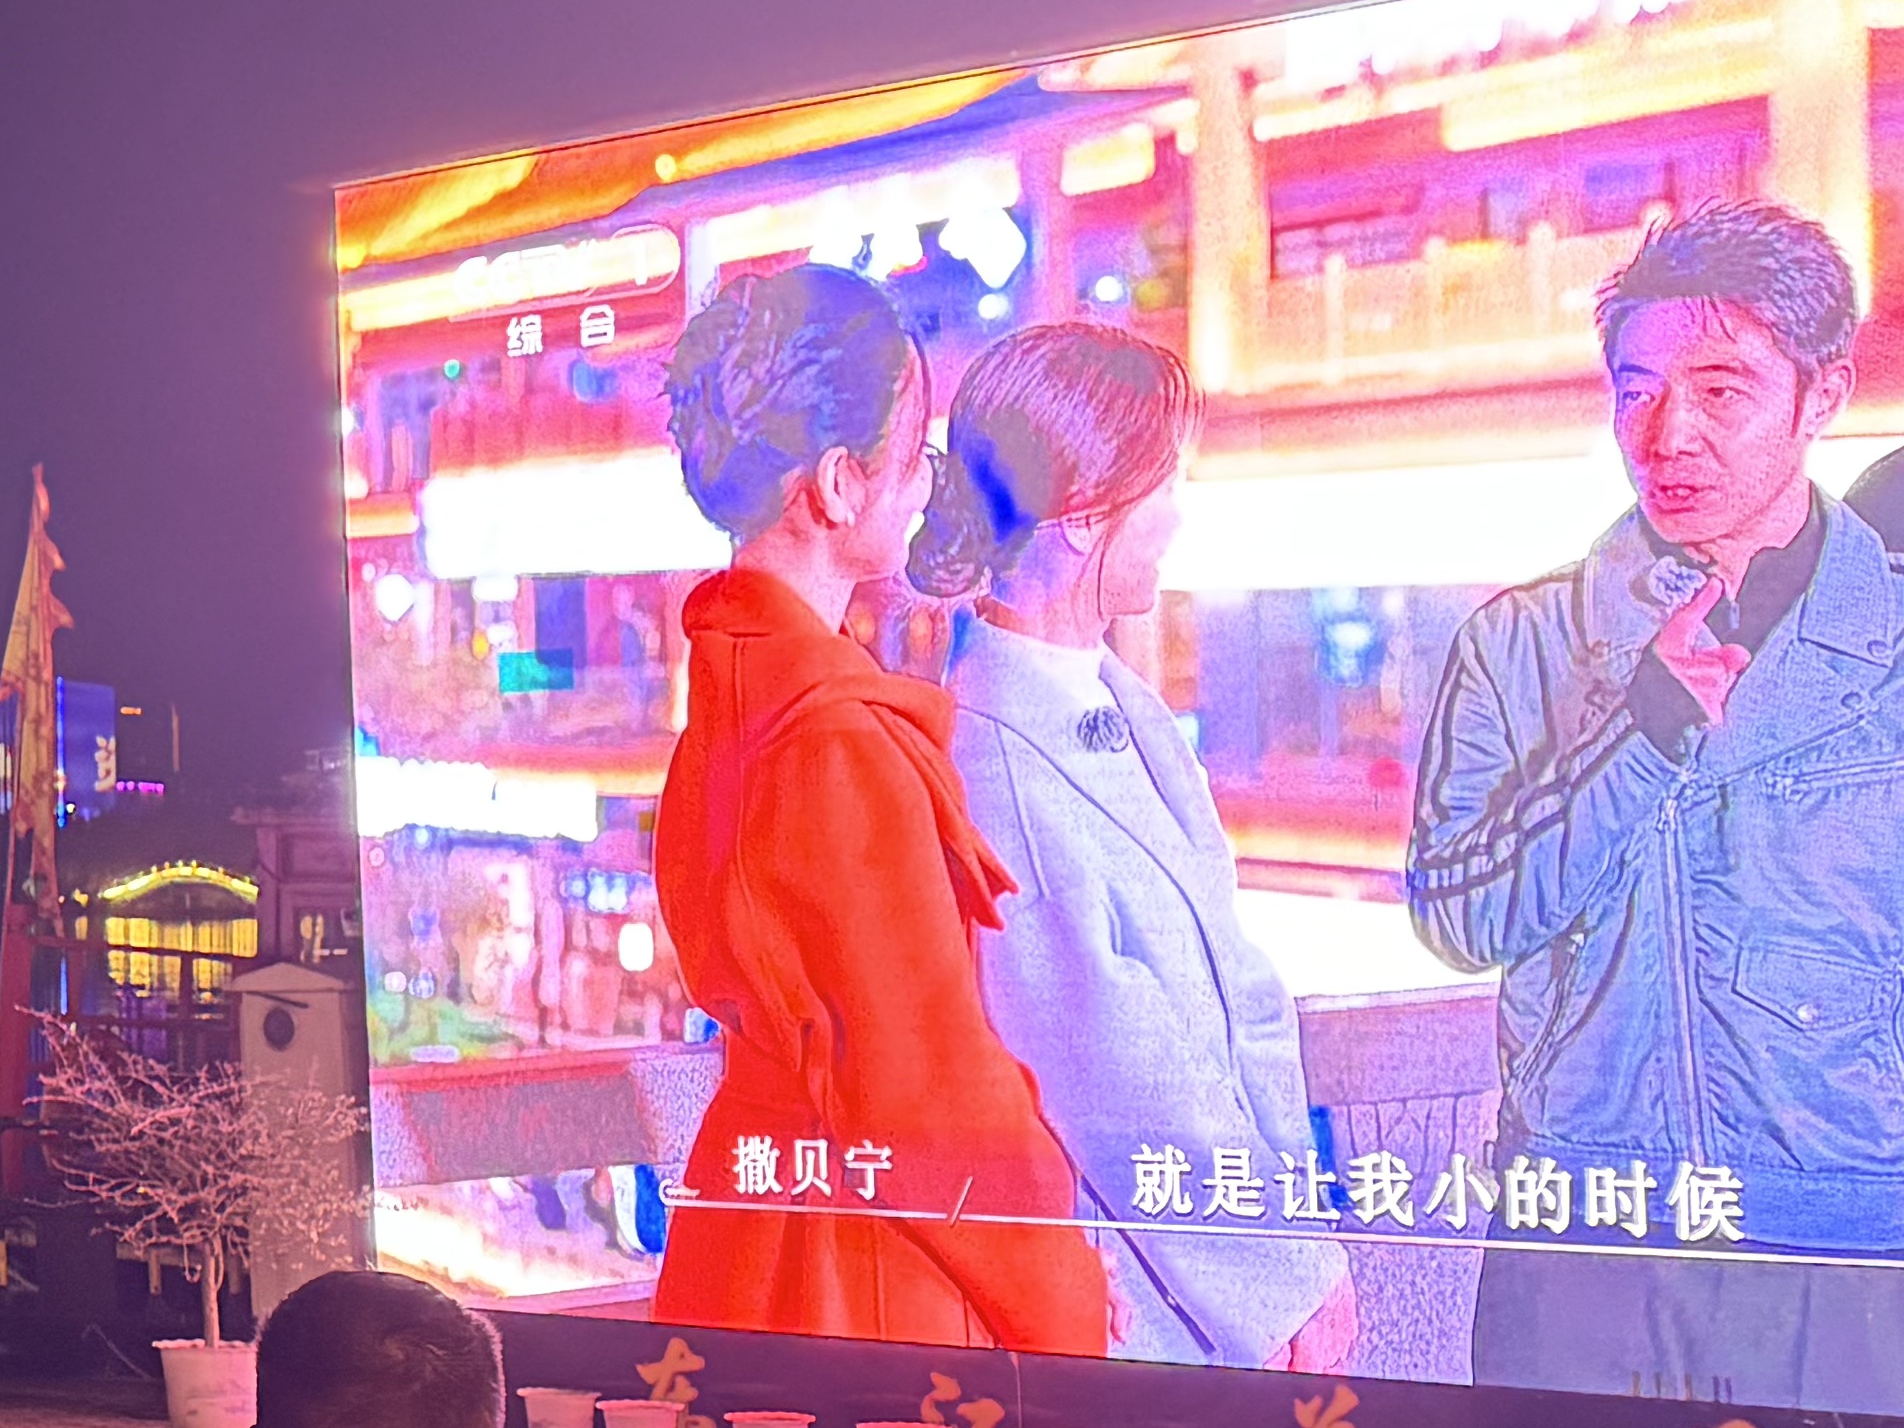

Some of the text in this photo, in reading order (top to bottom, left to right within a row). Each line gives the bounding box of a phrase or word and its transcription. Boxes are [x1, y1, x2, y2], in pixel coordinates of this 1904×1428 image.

[506, 304, 615, 357] 综合
[731, 1135, 893, 1201] 撒贝宁
[1130, 1143, 1746, 1243] 就是让我小的时候
